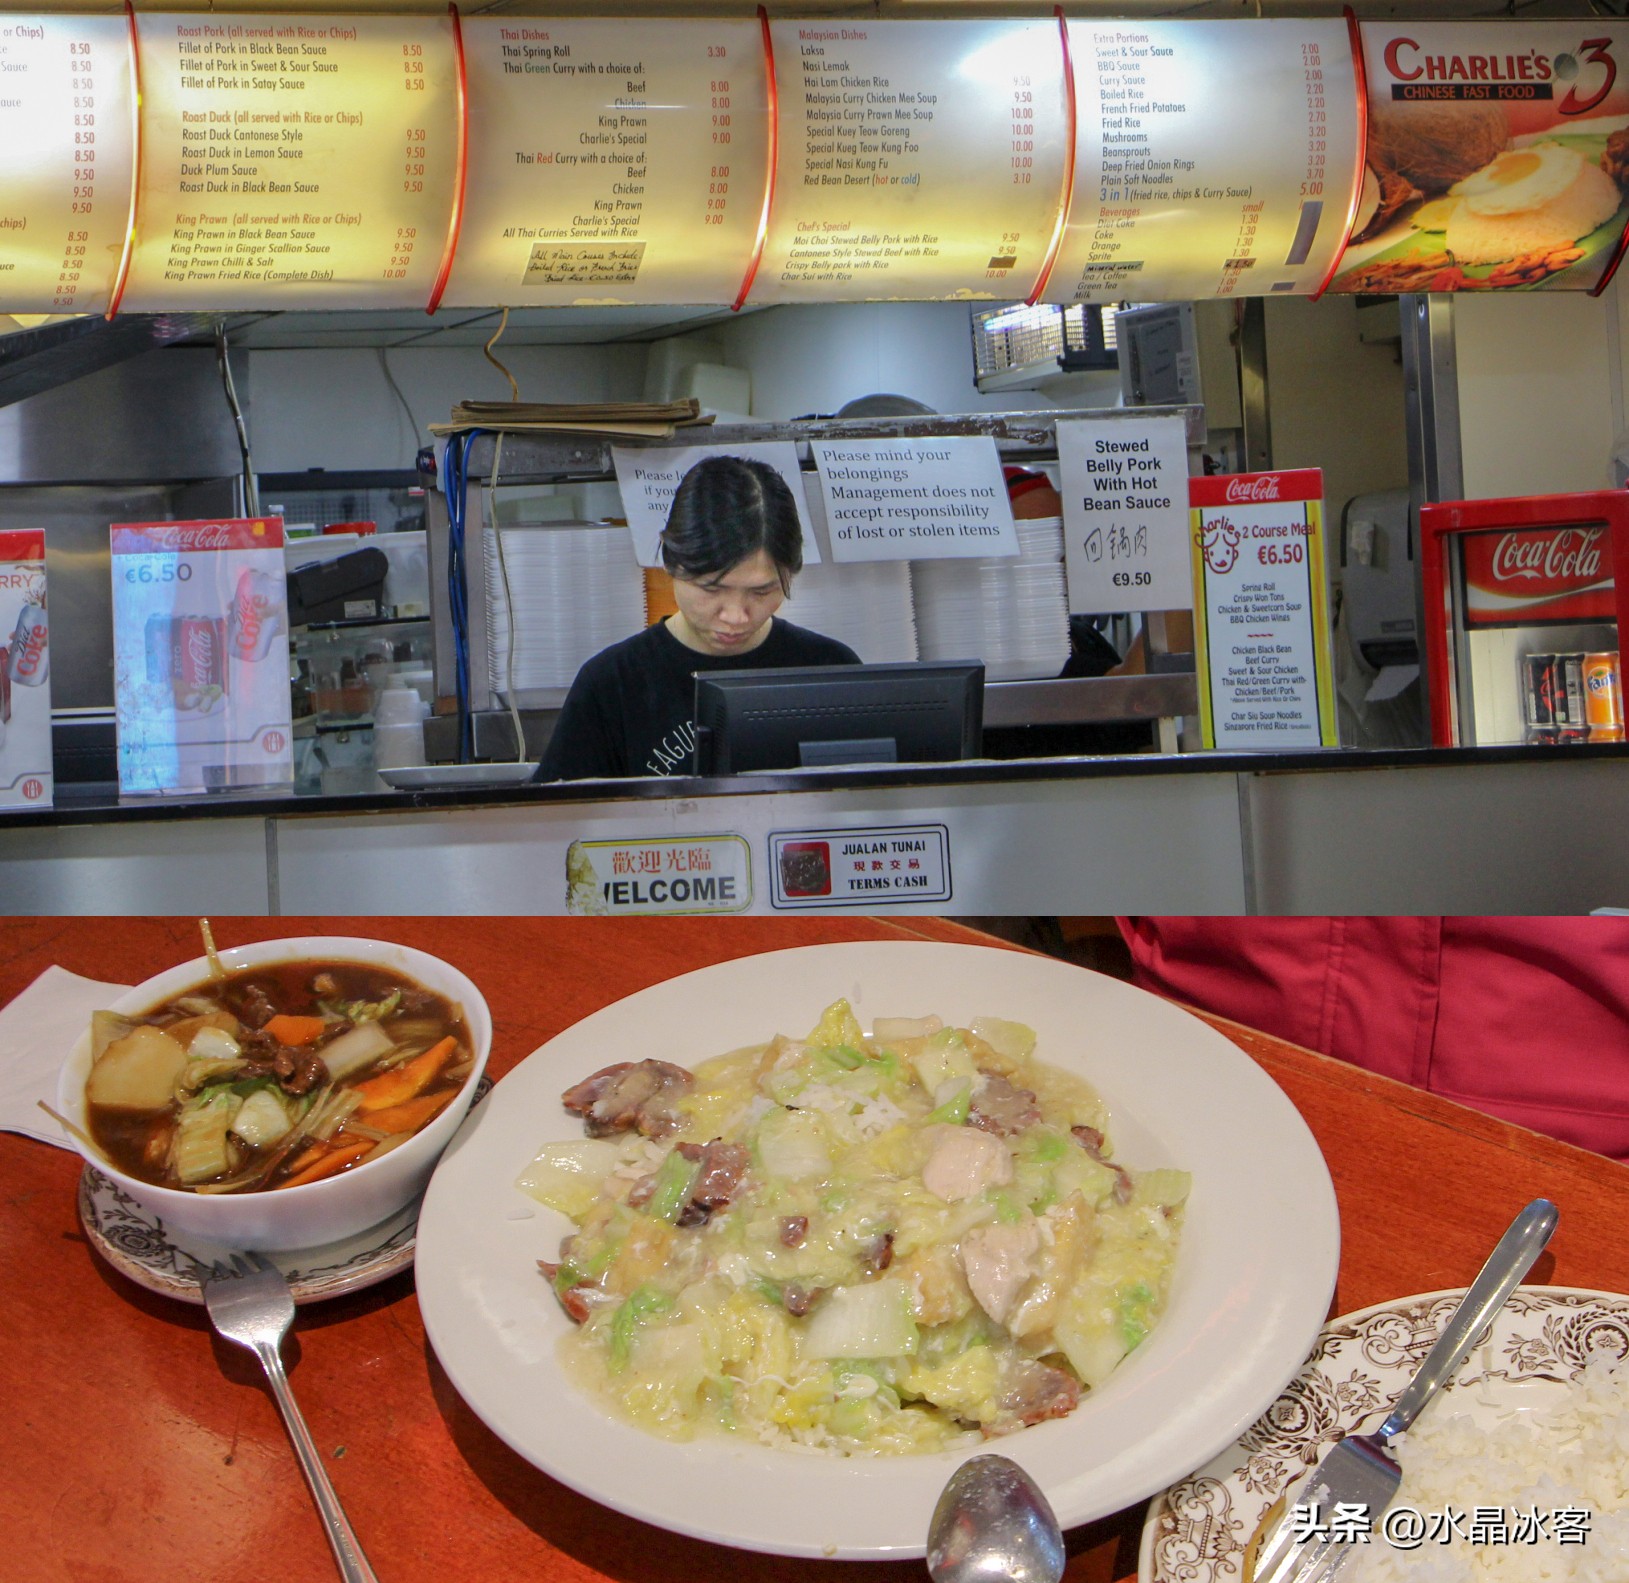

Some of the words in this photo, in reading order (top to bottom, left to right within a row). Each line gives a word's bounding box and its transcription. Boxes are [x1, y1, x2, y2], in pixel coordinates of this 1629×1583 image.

[178, 25, 201, 37] Roast
[204, 26, 224, 37] Pork
[228, 26, 243, 39] (all
[246, 27, 273, 37] served
[277, 27, 295, 38] with
[300, 27, 315, 38] Rice
[318, 29, 327, 38] or
[330, 27, 357, 40] Chips)
[501, 29, 519, 40] Thai
[522, 29, 549, 40] Dishes
[799, 30, 839, 42] Malaysian
[841, 30, 867, 40] Dishes
[179, 42, 202, 53] Fillet
[204, 42, 212, 53] of
[216, 43, 235, 54] Pork
[239, 43, 247, 54] in
[250, 43, 273, 54] Black
[277, 43, 298, 54] Bean
[301, 43, 327, 55] Sauce
[403, 44, 422, 56] 8.50
[502, 46, 520, 57] Thai
[524, 46, 551, 59] Spring
[554, 46, 570, 56] Roll
[708, 46, 726, 57] 3.30
[801, 46, 824, 56] Laksa
[504, 63, 522, 74] Thai
[525, 63, 550, 74] Green
[553, 63, 575, 76] Curry
[578, 63, 596, 74] with
[599, 66, 604, 74] a
[606, 63, 631, 74] choice
[634, 63, 644, 74] of:
[803, 61, 821, 71] Nasi
[823, 61, 850, 71] Lemak
[1558, 37, 1616, 115] 3
[627, 82, 646, 92] Beef
[711, 82, 728, 92] 8.00
[1404, 86, 1455, 98] CHINESE
[1463, 86, 1490, 98] FAST
[1499, 85, 1534, 98] FOOD
[1102, 103, 1128, 114] French
[1130, 103, 1150, 113] Fried
[1153, 102, 1186, 113] Potatoes
[1308, 98, 1324, 108] 2.20
[182, 129, 206, 140] Roast
[210, 129, 231, 140] Duck
[234, 129, 278, 141] Cantonese
[282, 129, 303, 143] Style
[406, 129, 425, 141] 9.50
[807, 125, 834, 138] Special
[837, 126, 857, 138] Kuey
[859, 125, 878, 137] Teow
[881, 126, 910, 138] Goreng
[1012, 125, 1033, 135] 10.00
[1309, 126, 1326, 136] 3.20
[75, 132, 94, 144] 8.50
[580, 133, 615, 144] Charlie's
[618, 133, 647, 146] Special
[712, 133, 730, 144] 9.00
[1102, 132, 1148, 142] Mushrooms
[1102, 161, 1122, 172] Deep
[1125, 160, 1145, 171] Fried
[1148, 160, 1172, 170] Onion
[1174, 160, 1194, 172] Rings
[74, 170, 94, 181] 9.50
[804, 175, 820, 185] Red
[822, 175, 842, 185] Bean
[845, 174, 870, 185] Desert
[872, 173, 888, 186] (hot
[891, 177, 899, 185] or
[901, 173, 920, 186] cold)
[1013, 173, 1030, 184] 3.10
[1300, 182, 1322, 195] 5.00
[1100, 208, 1140, 216] Beverages
[1242, 202, 1264, 212] small
[797, 222, 820, 232] Chef's
[822, 222, 850, 233] Special
[68, 232, 88, 241] 8.50
[1095, 231, 1113, 239] Coke
[1092, 242, 1120, 251] Orange
[164, 270, 184, 281] King
[188, 270, 215, 280] Prawn
[218, 270, 240, 280] Fried
[244, 270, 261, 280] Rice
[264, 270, 308, 281] (Complete
[311, 270, 333, 280] Dish)
[383, 270, 405, 278] 10.00
[1095, 440, 1149, 453] Stewed
[824, 451, 870, 461] Please
[876, 450, 913, 461] mind
[917, 452, 951, 463] your
[1086, 459, 1123, 475] Belly
[1128, 458, 1161, 471] Pork
[635, 469, 672, 481] Please
[827, 467, 909, 482] belongings
[1094, 477, 1126, 491] With
[1132, 477, 1158, 489] Hot
[1226, 476, 1280, 502] Coca-Cola
[645, 486, 653, 495] if
[831, 486, 927, 501] Management
[933, 485, 966, 498] does
[971, 486, 995, 498] not
[648, 503, 668, 512] any
[1084, 497, 1121, 511] Bean
[1126, 496, 1171, 509] Sauce
[835, 507, 883, 521] accept
[888, 504, 989, 520] responsibility
[838, 526, 852, 539] of
[857, 526, 884, 538] lost
[889, 527, 904, 537] or
[909, 524, 955, 537] stolen
[959, 524, 1000, 536] items
[1242, 527, 1248, 538] 2
[1252, 525, 1287, 538] Course
[1291, 522, 1315, 536] Meal
[1258, 544, 1302, 564] €6.50
[1492, 528, 1604, 580] Coca-Cola
[125, 563, 192, 583] €6.50
[1112, 572, 1152, 586] €9.50
[1230, 616, 1244, 624] BBQ
[1246, 615, 1269, 623] Chicken
[1271, 614, 1290, 622] Wings
[16, 624, 48, 676] Coke
[1276, 645, 1292, 653] Bean
[1246, 656, 1260, 664] Beef
[1261, 656, 1279, 664] Curry
[1274, 666, 1298, 674] Chicken
[1231, 712, 1246, 720] Char
[1248, 712, 1258, 720] Siu
[1277, 711, 1302, 719] Noodles
[842, 843, 887, 855] JUALAN
[891, 840, 925, 852] TUNAI
[613, 848, 711, 875] 歡迎光臨
[848, 878, 890, 889] TERMS
[895, 876, 928, 887] CASH
